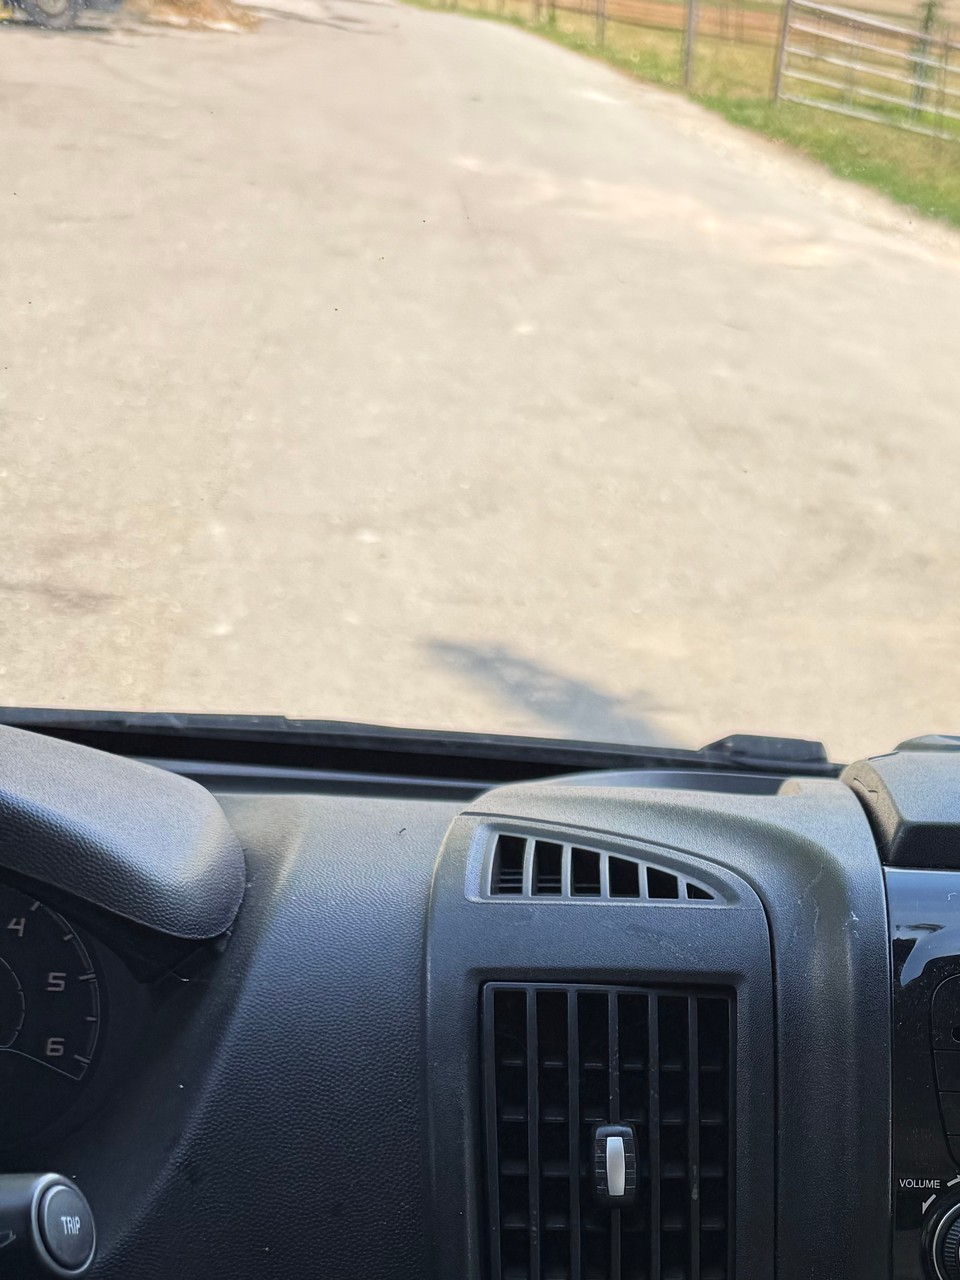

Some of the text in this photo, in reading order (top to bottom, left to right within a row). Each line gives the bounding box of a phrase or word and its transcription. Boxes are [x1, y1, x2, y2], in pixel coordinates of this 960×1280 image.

[8, 917, 26, 937] 4
[45, 971, 66, 992] 5
[45, 1037, 65, 1057] 6
[899, 1178, 941, 1189] VOLUME
[61, 1214, 81, 1235] TRIP
